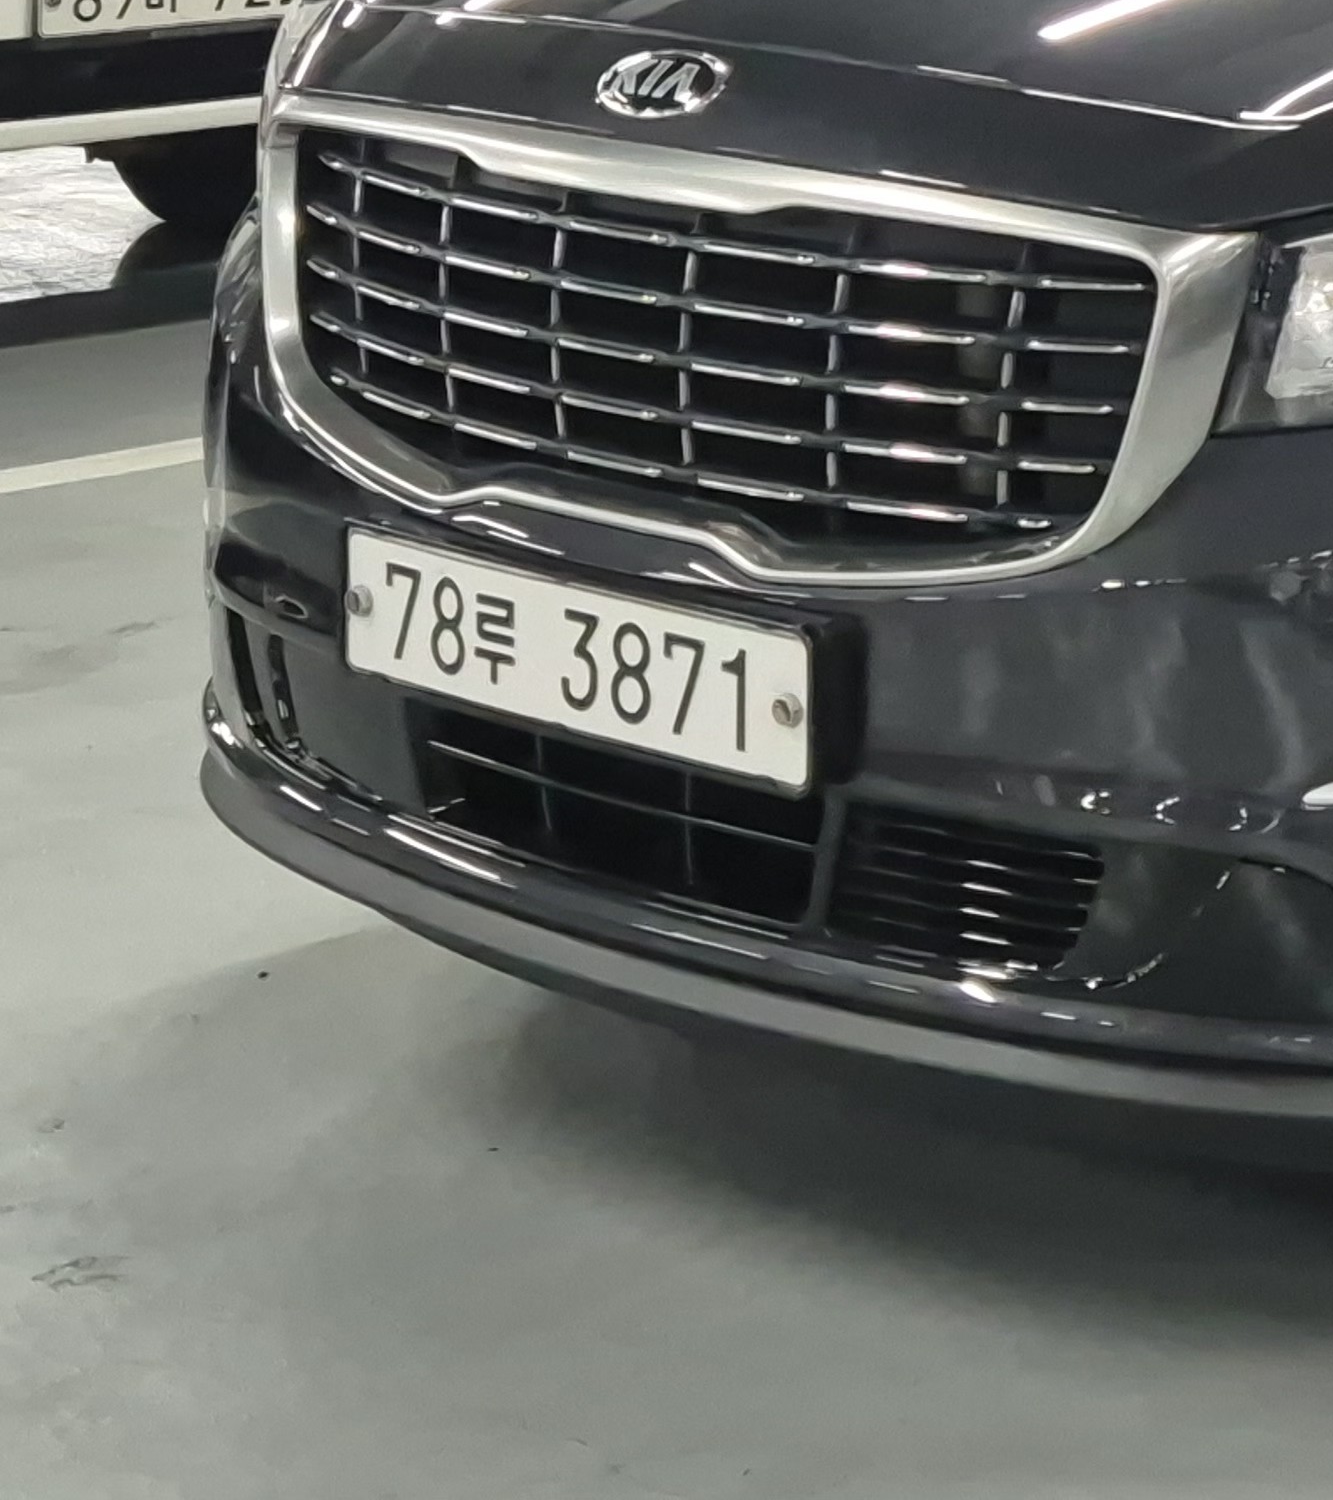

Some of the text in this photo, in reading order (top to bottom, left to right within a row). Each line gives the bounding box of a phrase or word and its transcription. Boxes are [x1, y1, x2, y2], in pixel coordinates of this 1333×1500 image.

[609, 59, 700, 104] KIA
[386, 562, 746, 752] 78루 3871
